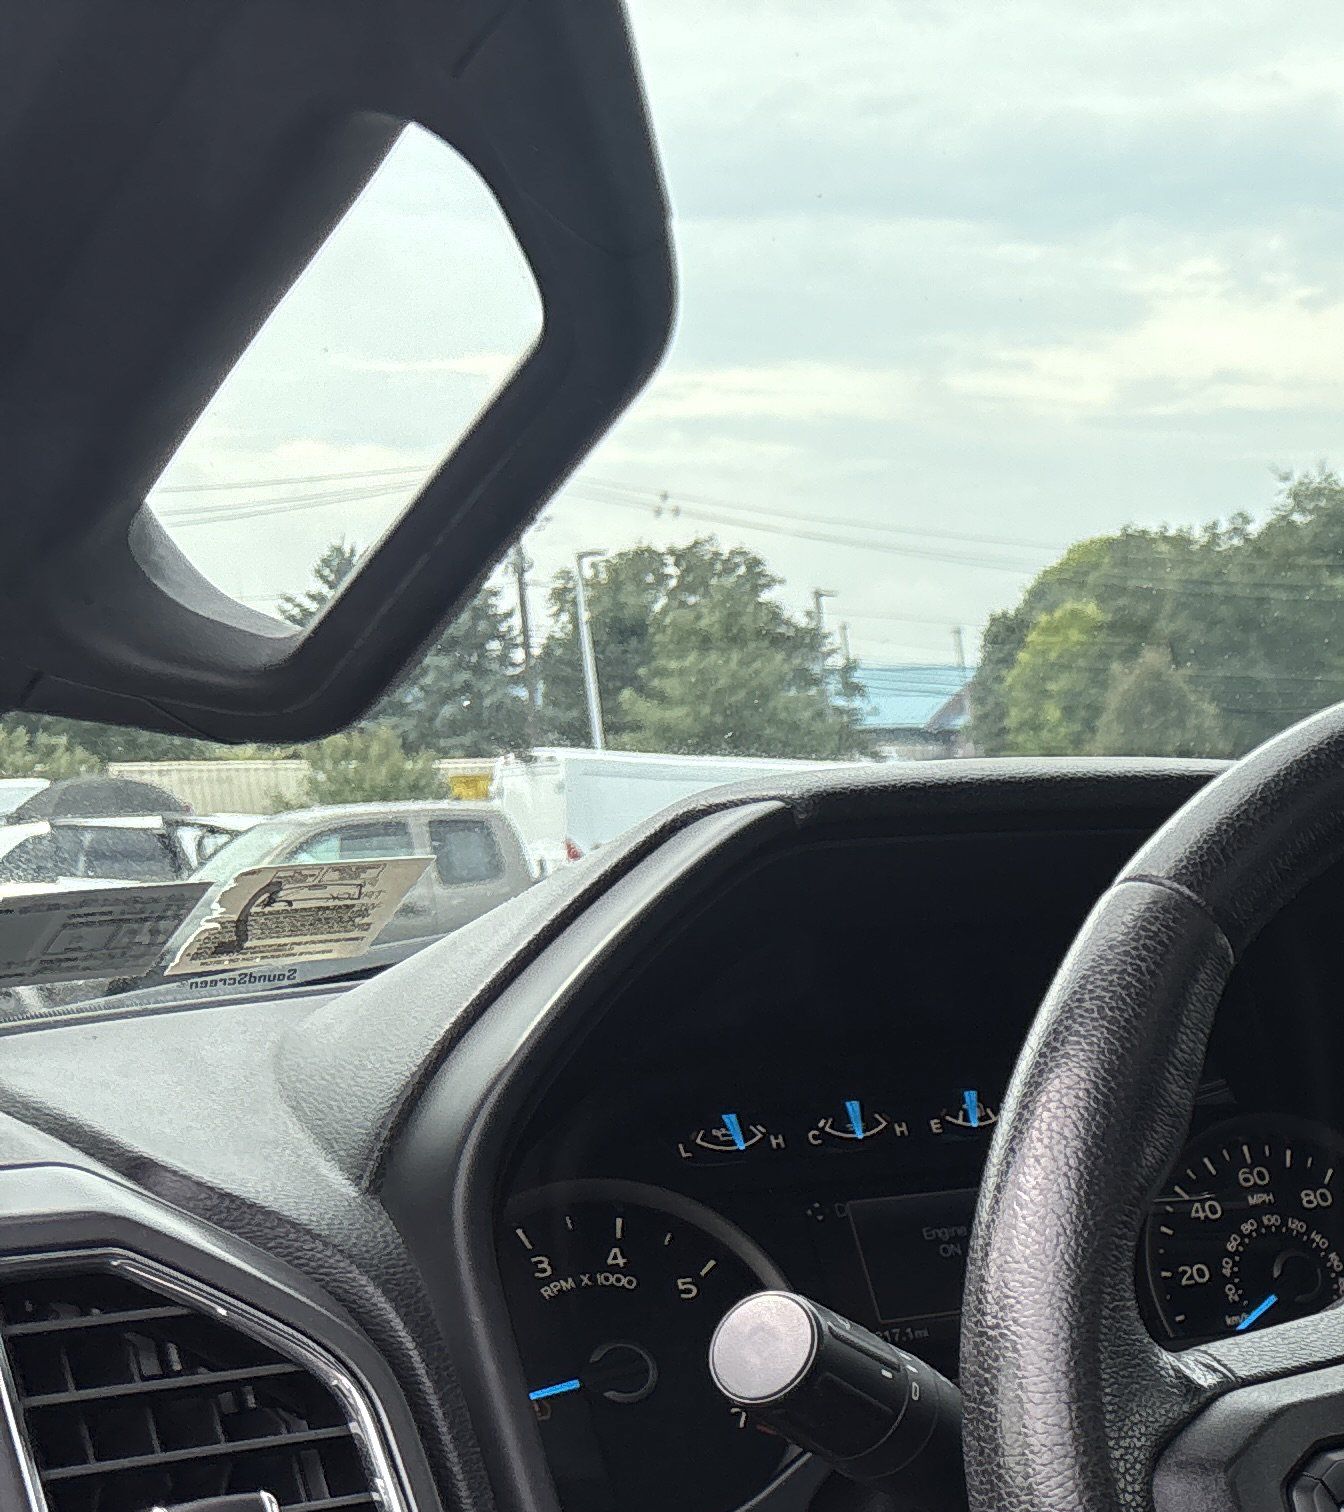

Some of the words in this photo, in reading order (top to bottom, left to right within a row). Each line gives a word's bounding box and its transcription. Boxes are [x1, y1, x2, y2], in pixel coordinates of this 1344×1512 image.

[895, 1122, 908, 1136] H
[931, 1118, 942, 1134] E
[770, 1134, 785, 1149] H
[808, 1130, 823, 1145] C
[680, 1142, 693, 1158] L
[1238, 1166, 1271, 1187] 60
[1247, 1192, 1275, 1207] MPH
[1300, 1187, 1333, 1209] 80
[1191, 1200, 1223, 1221] 40
[1240, 1218, 1258, 1234] 80
[1261, 1214, 1282, 1227] 100
[1287, 1217, 1307, 1234] 120
[921, 1225, 968, 1241] Engine
[1309, 1230, 1329, 1249] 140
[606, 1247, 628, 1268] 4
[938, 1244, 962, 1258] ON
[532, 1256, 553, 1278] 3
[1178, 1264, 1211, 1286] 20
[1222, 1258, 1233, 1277] 40
[540, 1276, 576, 1300] RPM
[596, 1273, 638, 1290] 1000
[677, 1278, 699, 1300] 5
[1225, 1283, 1239, 1303] 20
[730, 1407, 749, 1429] 7
